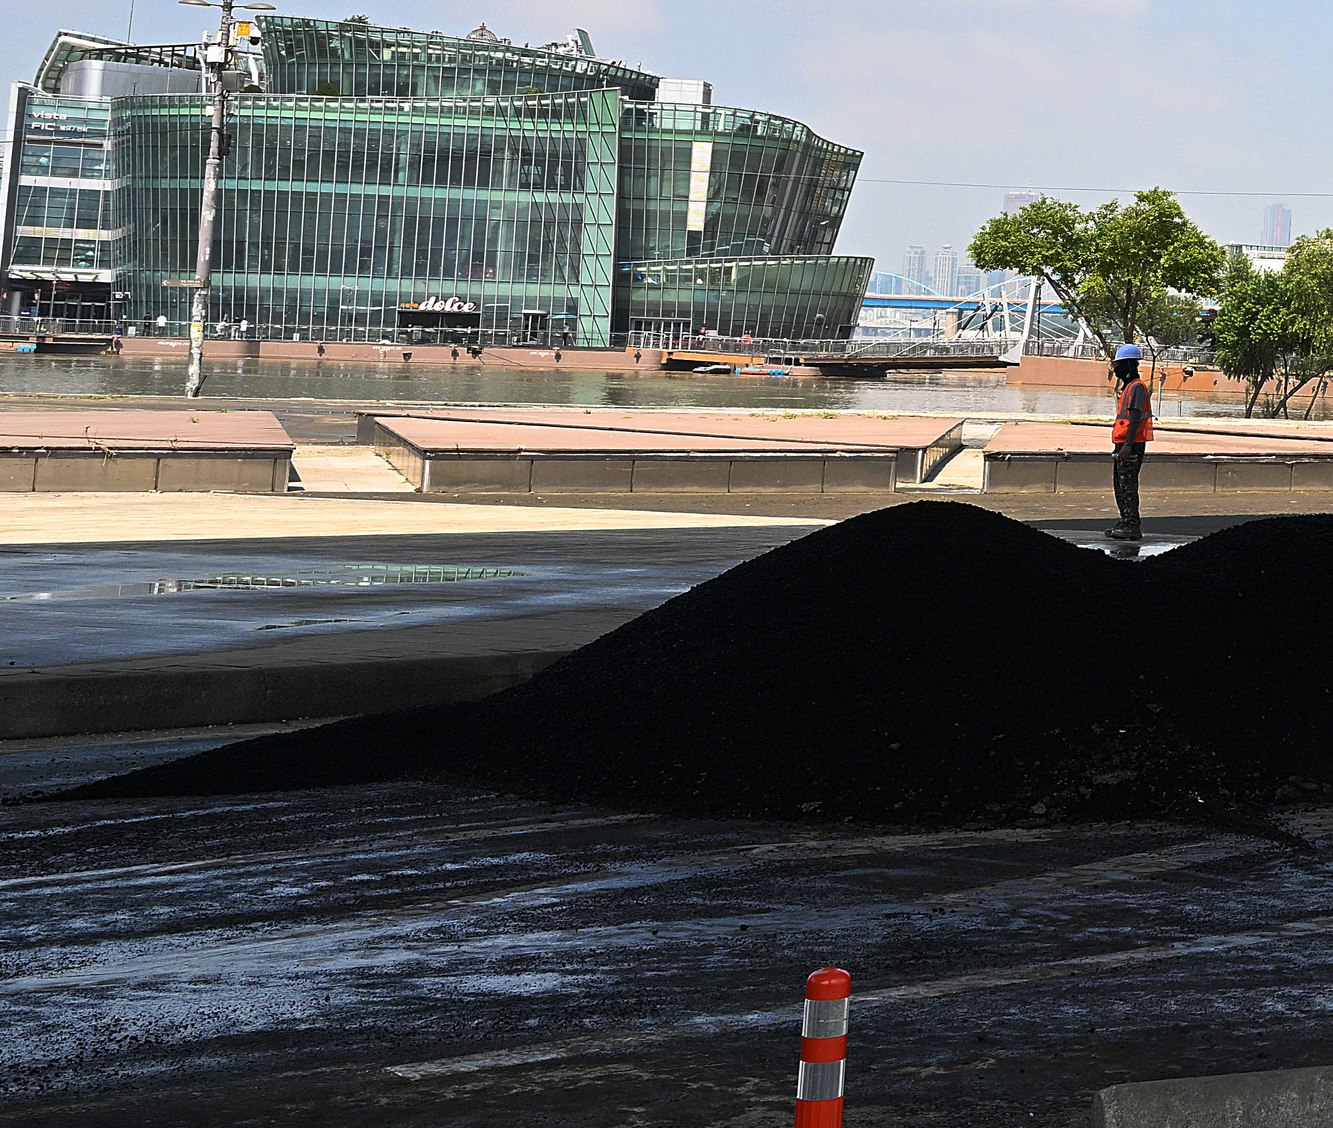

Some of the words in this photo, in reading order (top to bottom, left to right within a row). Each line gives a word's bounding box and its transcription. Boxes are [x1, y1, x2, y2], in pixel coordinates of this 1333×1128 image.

[31, 111, 68, 120] vista
[31, 122, 56, 131] FIC
[419, 296, 477, 312] dolce
